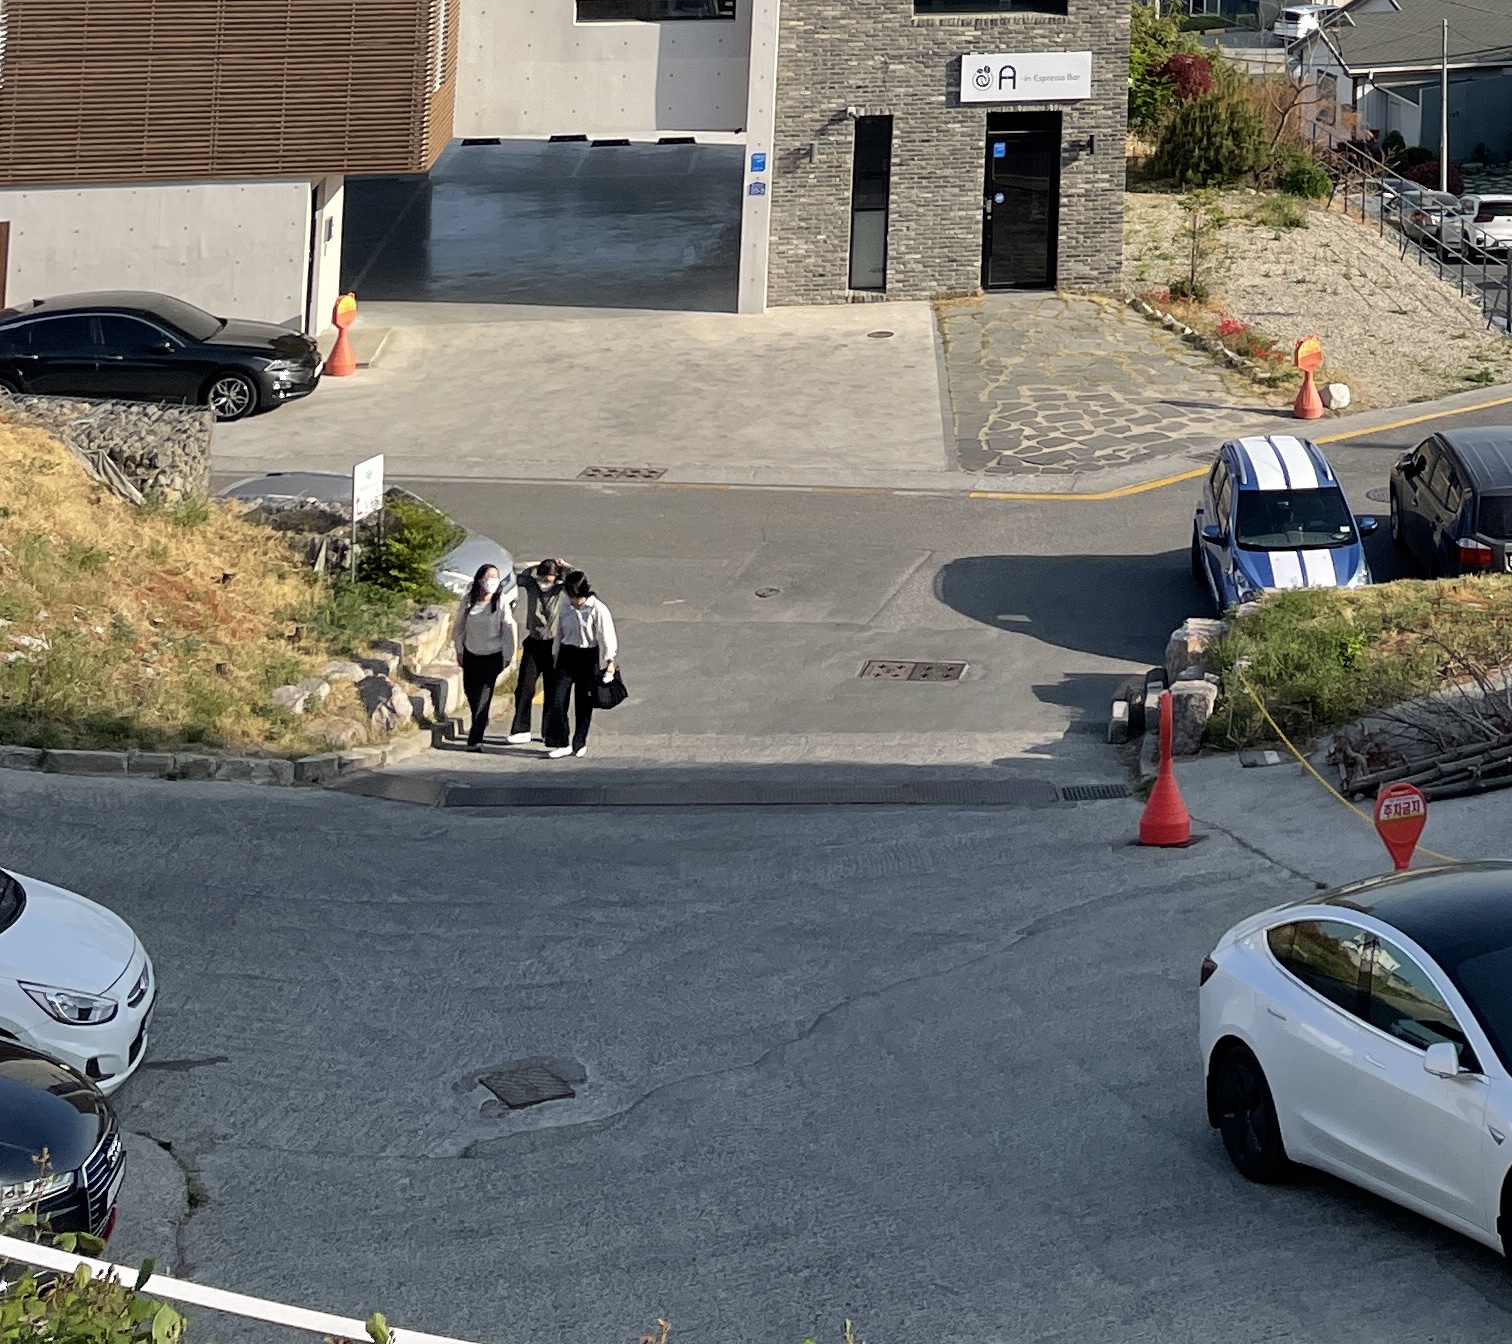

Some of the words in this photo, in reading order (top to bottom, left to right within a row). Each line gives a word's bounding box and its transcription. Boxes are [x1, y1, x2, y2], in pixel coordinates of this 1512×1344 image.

[1033, 74, 1065, 83] Espresso
[1066, 73, 1080, 81] Bar
[1384, 800, 1419, 818] 주차금지
